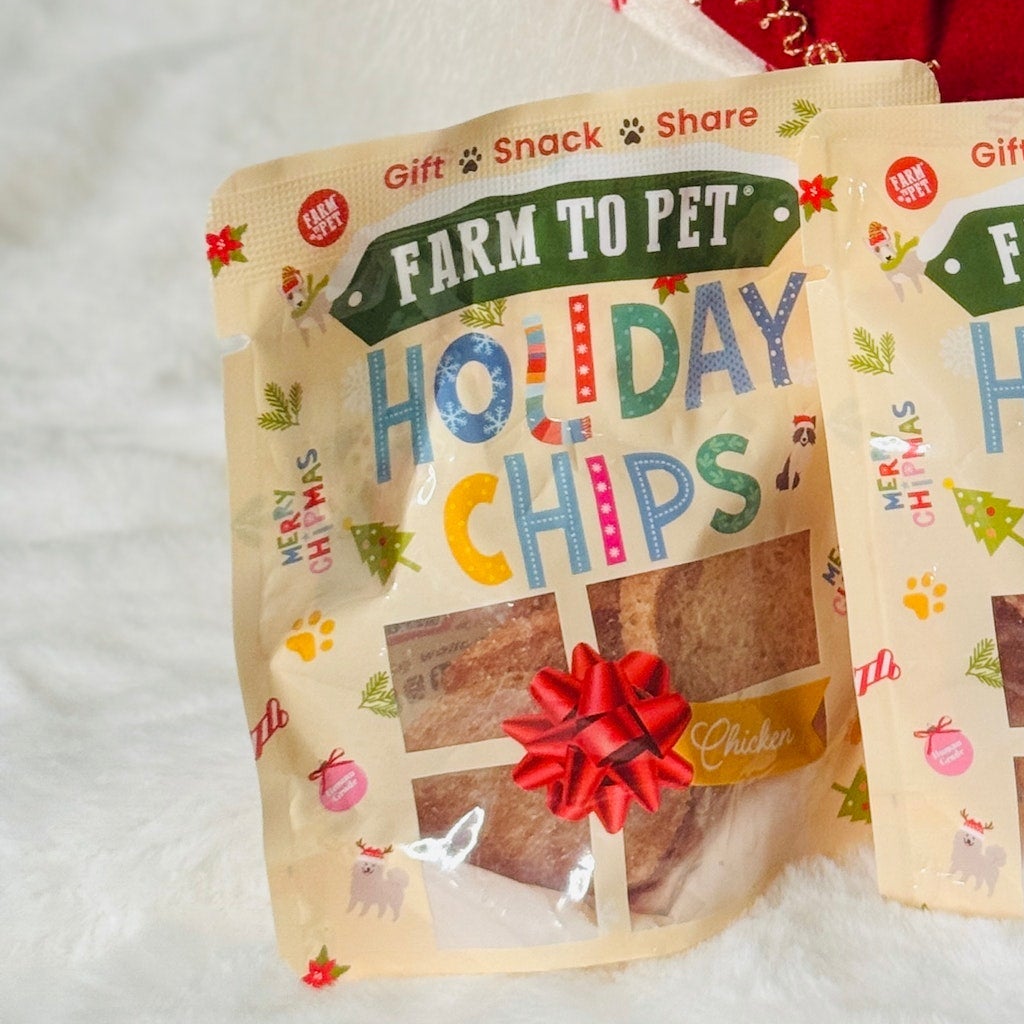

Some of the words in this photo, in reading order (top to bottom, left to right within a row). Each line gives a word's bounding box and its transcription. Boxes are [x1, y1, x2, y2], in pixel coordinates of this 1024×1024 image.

[384, 155, 445, 189] Gift
[493, 121, 603, 164] Snack
[656, 106, 759, 138] Share
[889, 162, 926, 192] FARM
[303, 195, 339, 229] FARM
[907, 178, 932, 202] PET
[319, 210, 344, 238] PET
[390, 204, 541, 307] FARM
[556, 193, 628, 261] TO
[366, 271, 807, 484] HOLIDAY
[273, 489, 303, 566] MERRY
[443, 432, 763, 589] CHIPS
[690, 717, 795, 771] Chicken
